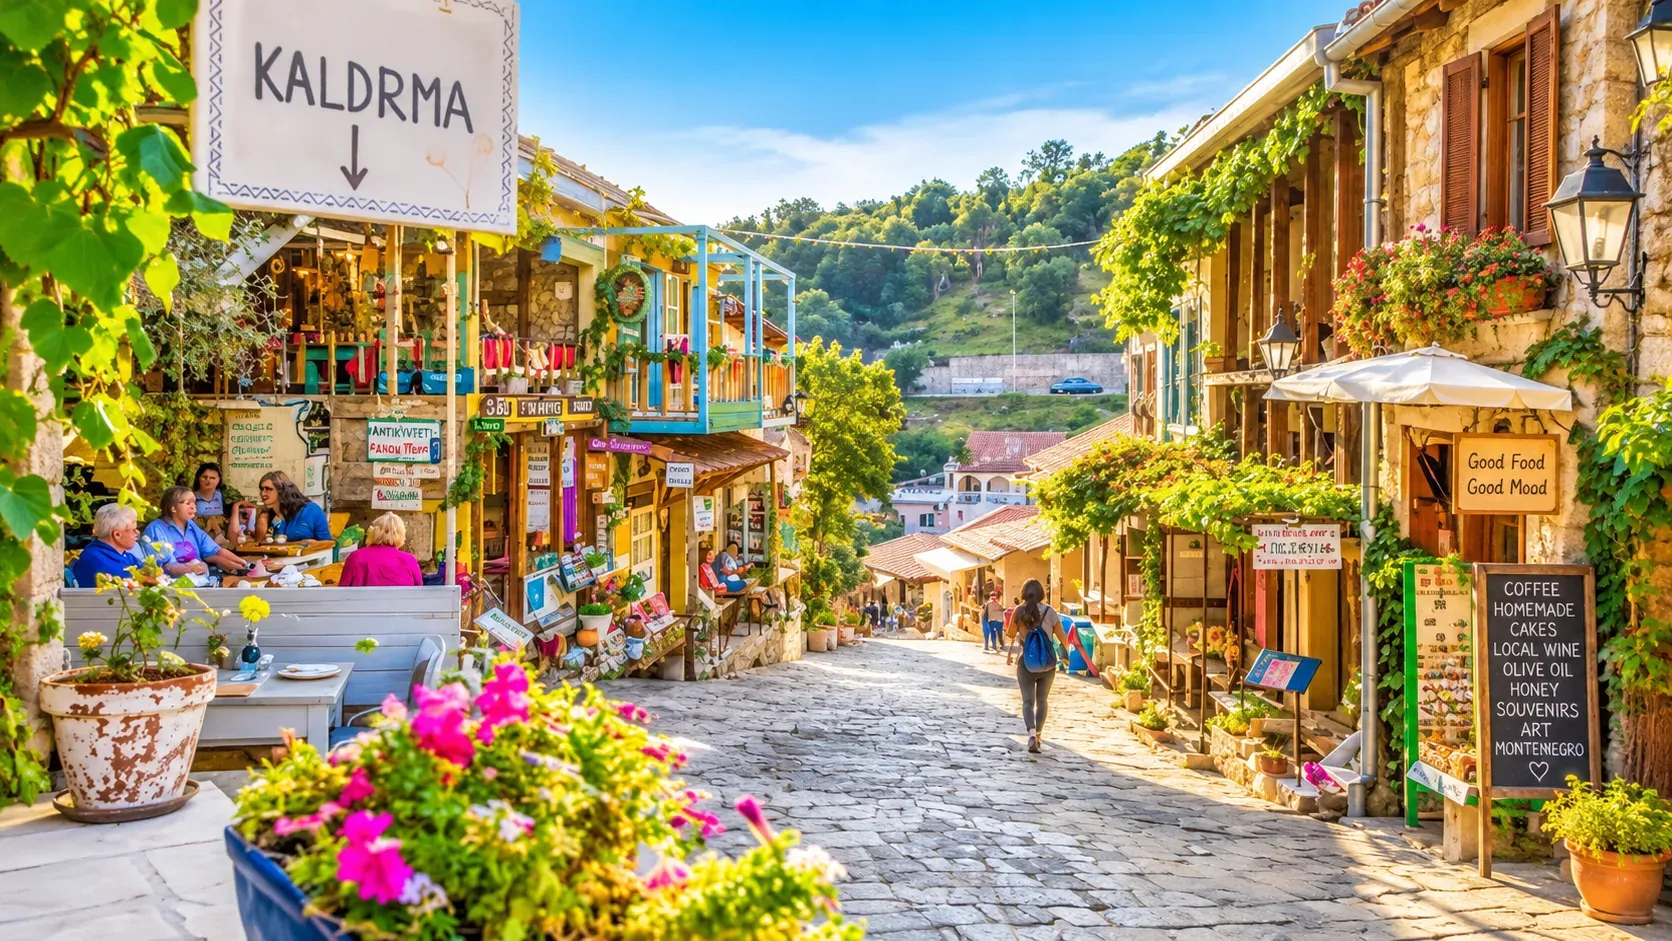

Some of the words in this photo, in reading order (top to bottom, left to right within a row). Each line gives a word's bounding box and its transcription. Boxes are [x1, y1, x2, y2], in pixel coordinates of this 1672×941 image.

[255, 41, 474, 134] KALDRMA
[1468, 452, 1505, 470] Good
[1511, 453, 1545, 470] Food
[1467, 477, 1504, 495] Good
[1510, 478, 1547, 495] Mood
[1504, 581, 1560, 597] COFFEE
[1494, 601, 1576, 617] HOMEMADE
[1510, 621, 1558, 637] CAKES
[1493, 641, 1539, 657] LOCAL
[1543, 642, 1581, 658] WINE
[1503, 661, 1545, 677] OLIVE
[1550, 662, 1574, 678] OIL
[1510, 681, 1560, 698] HONEY
[1496, 701, 1579, 718] SOUVENIRS
[1520, 721, 1552, 738] ART
